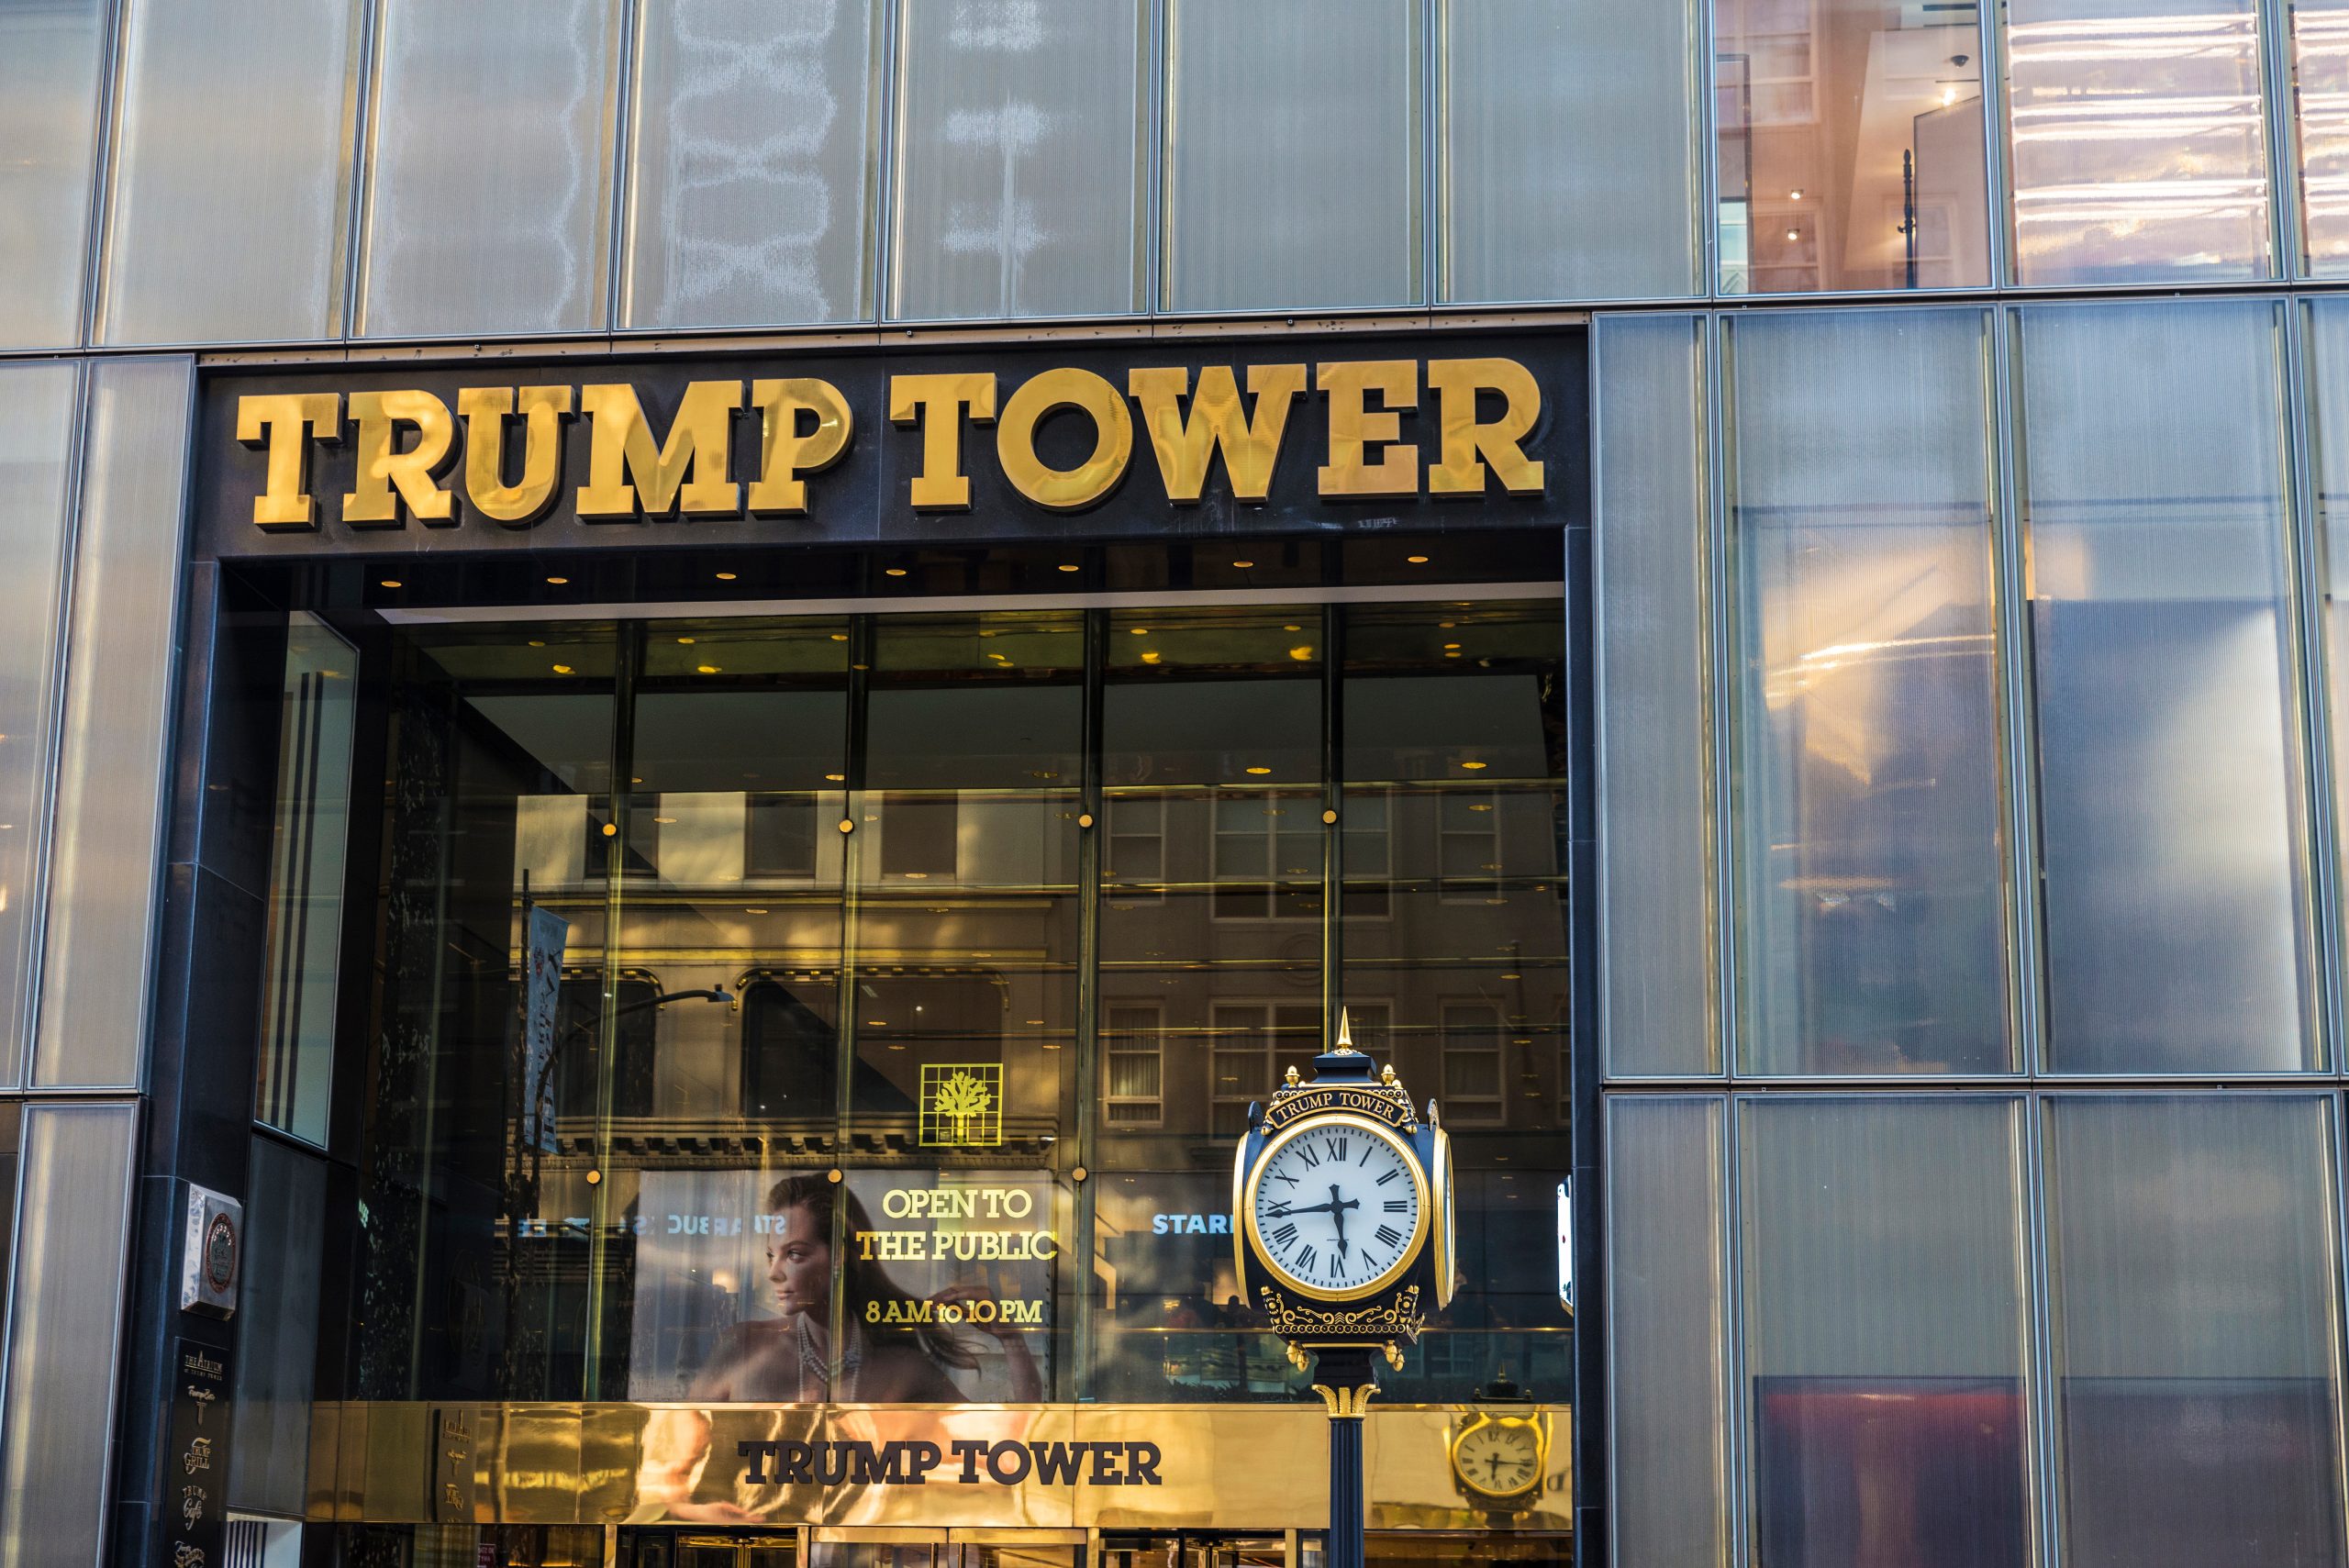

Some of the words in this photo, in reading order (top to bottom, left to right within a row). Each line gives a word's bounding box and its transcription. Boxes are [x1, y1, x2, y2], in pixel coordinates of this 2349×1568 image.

[236, 377, 855, 528] TRUMP
[890, 357, 1545, 511] TOWER
[1276, 1092, 1332, 1121] TRUMP
[1339, 1092, 1395, 1119] TOWER
[882, 1189, 979, 1219] OPEN
[983, 1189, 1032, 1219] TO
[856, 1230, 926, 1262] THE
[931, 1230, 1058, 1262] PUBLIC
[938, 1303, 963, 1324] to
[737, 1440, 942, 1486] TRUMP
[952, 1439, 1162, 1486] TOWER
